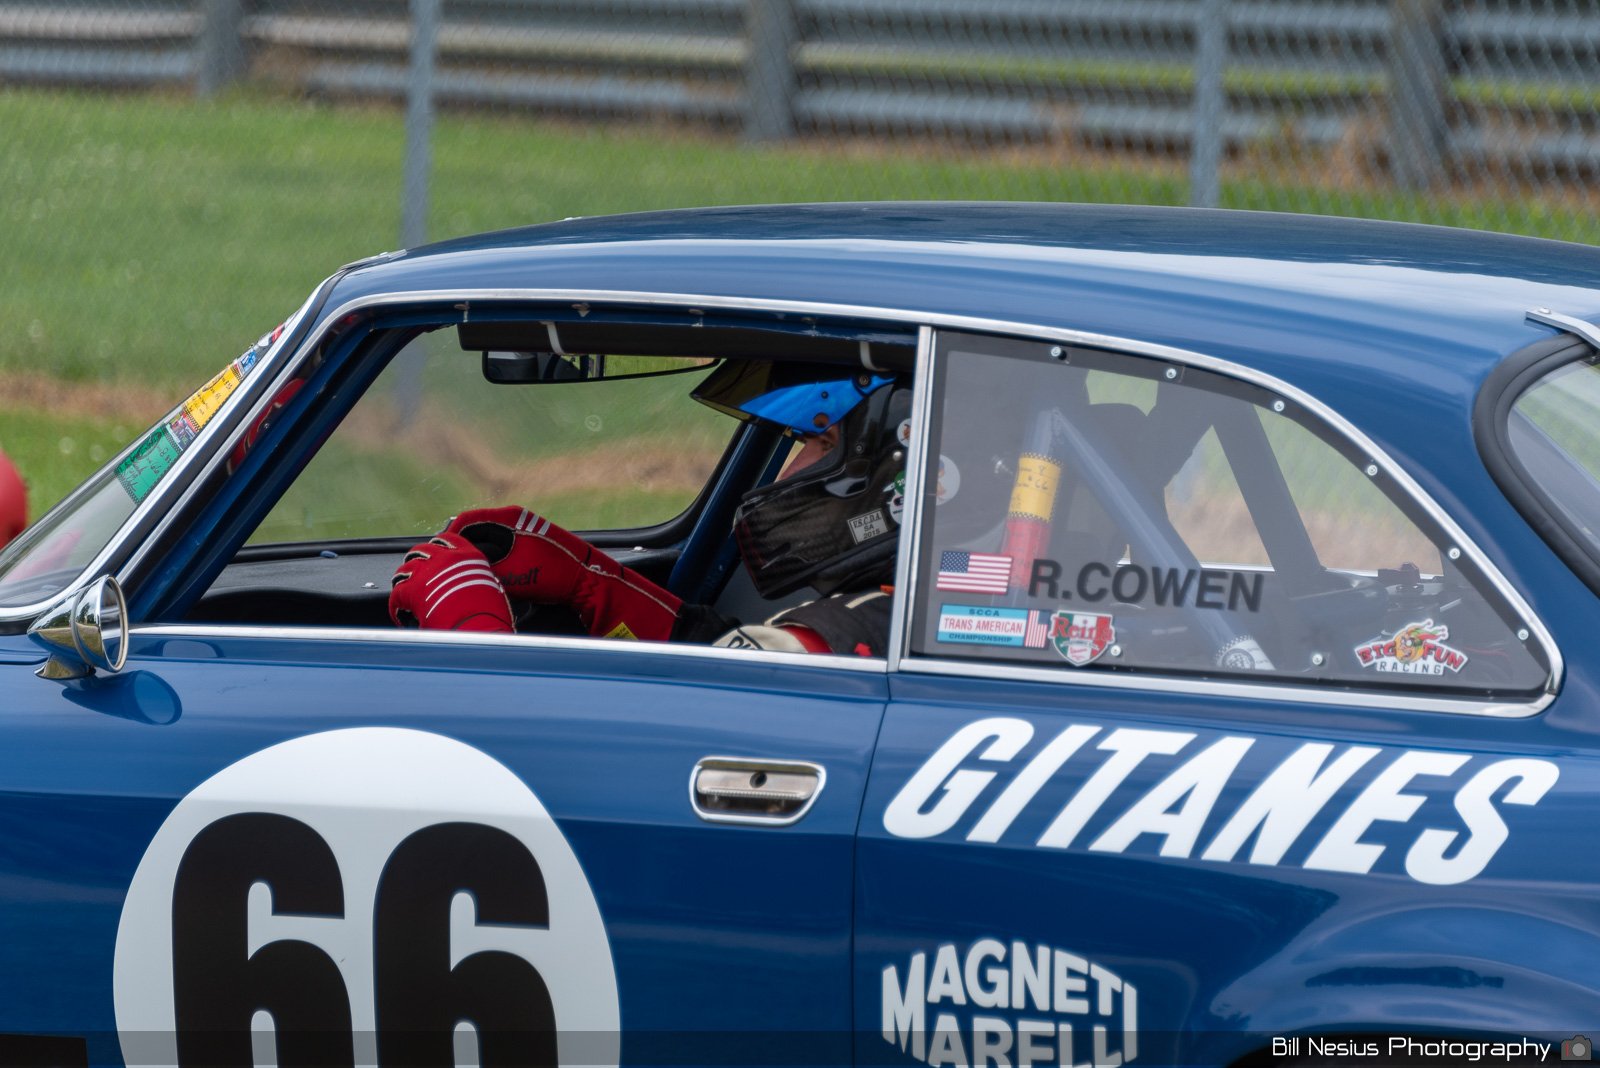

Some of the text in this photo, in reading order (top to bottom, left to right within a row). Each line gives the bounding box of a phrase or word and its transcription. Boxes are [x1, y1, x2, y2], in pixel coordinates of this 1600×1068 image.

[863, 523, 875, 532] SA
[863, 529, 881, 540] 2015
[498, 566, 543, 587] abelt
[1027, 558, 1265, 613] R.COWEN
[968, 608, 1000, 617] SCCA
[944, 617, 1023, 634] TRANS AMERICAN
[1051, 616, 1114, 642] Reina
[948, 633, 1013, 643] CHAMPIONSHIP
[1358, 641, 1464, 669] BIG FUN
[1379, 660, 1442, 675] RACING
[882, 717, 1560, 886] GITANES
[171, 811, 558, 1068] 66
[882, 938, 1138, 1063] MAGNETI
